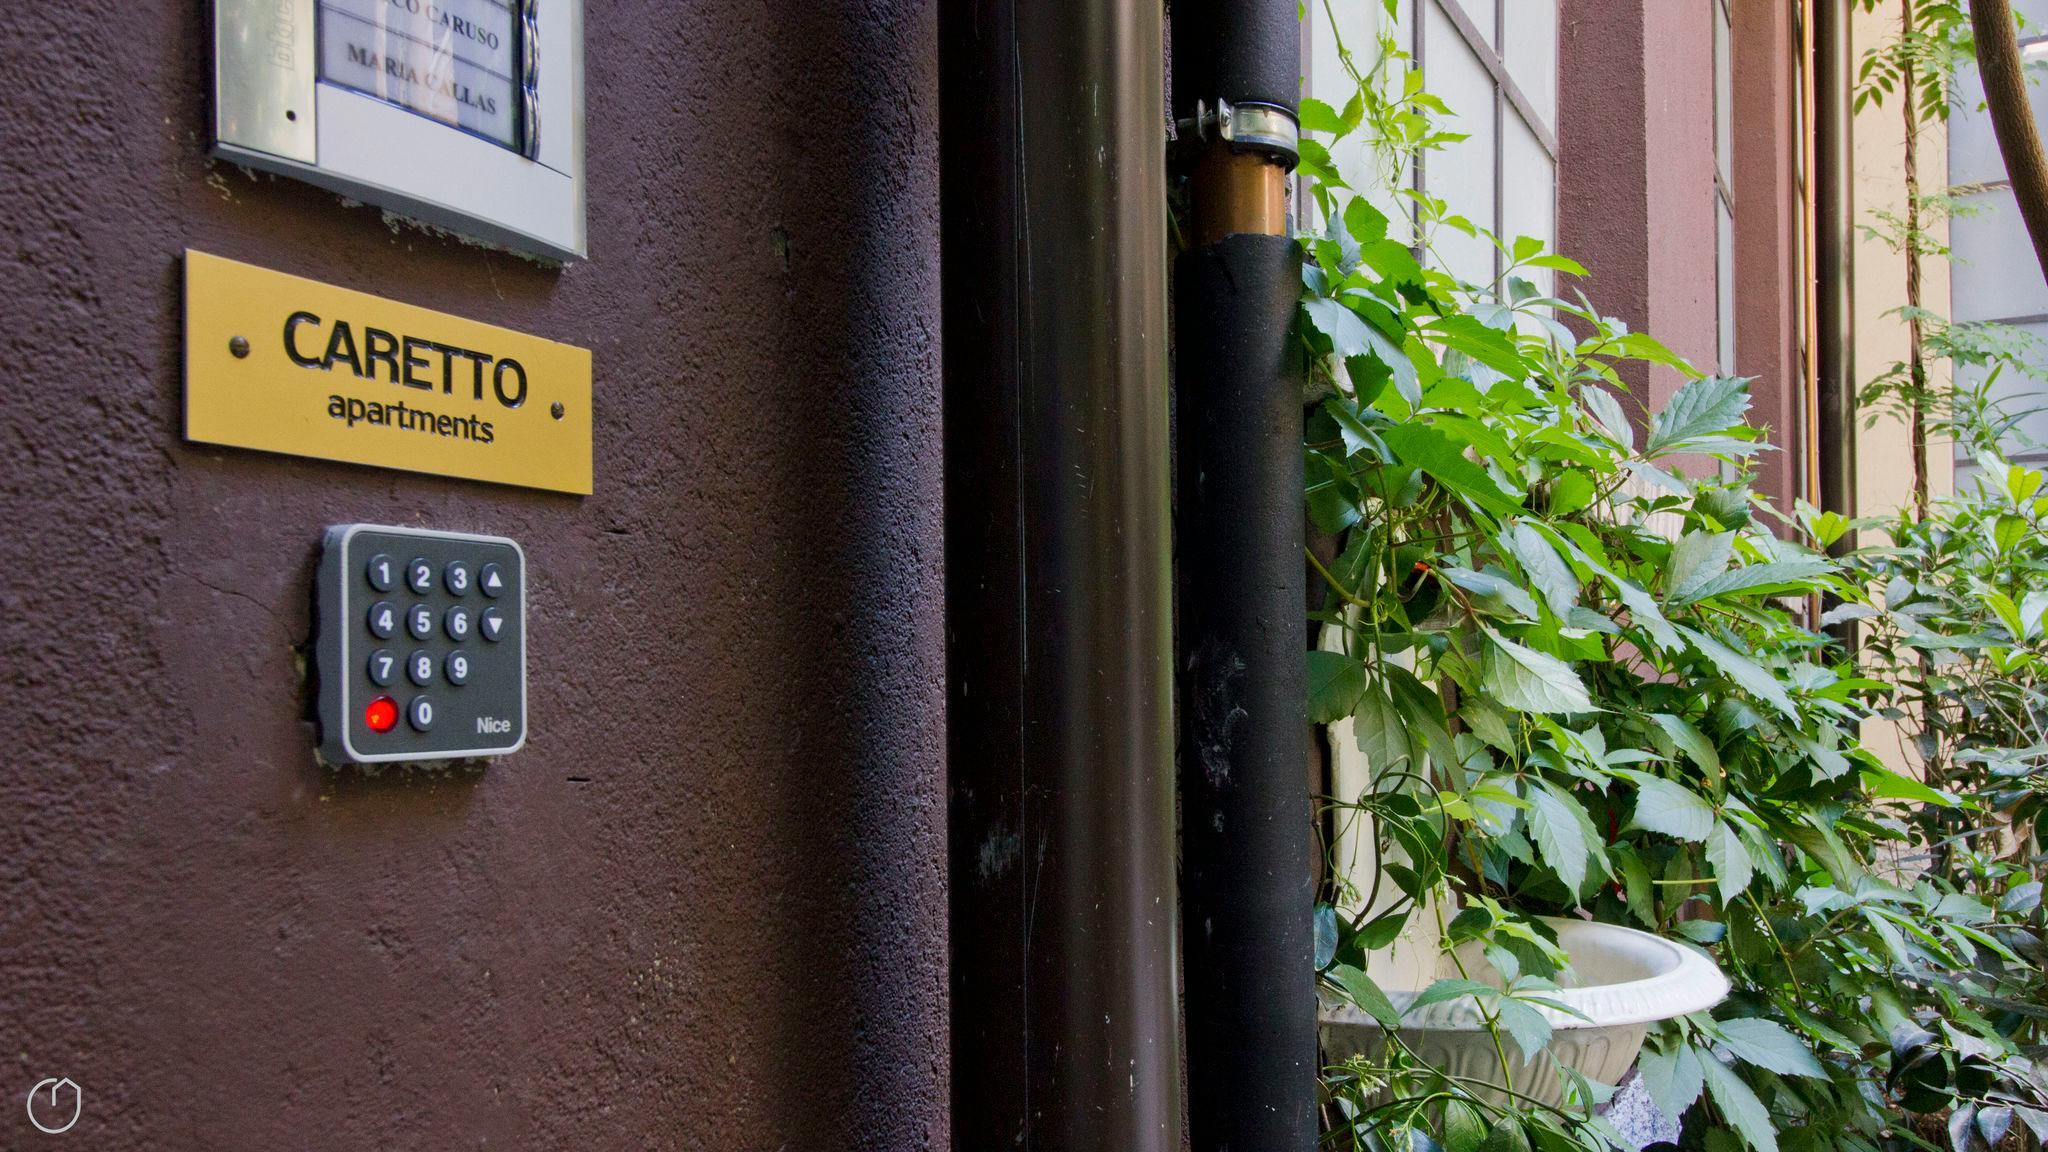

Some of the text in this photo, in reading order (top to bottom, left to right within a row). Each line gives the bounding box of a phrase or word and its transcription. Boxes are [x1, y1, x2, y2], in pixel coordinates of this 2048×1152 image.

[426, 5, 499, 51] CARUSO
[347, 42, 497, 115] MARIA CALLAS
[283, 311, 528, 409] CARETTO
[327, 394, 495, 445] apartments
[379, 562, 468, 589] 1 2 3
[378, 609, 468, 634] 4 5 6
[379, 657, 468, 679] 7 8 9
[418, 702, 433, 725] 0
[476, 717, 512, 734] Nice
